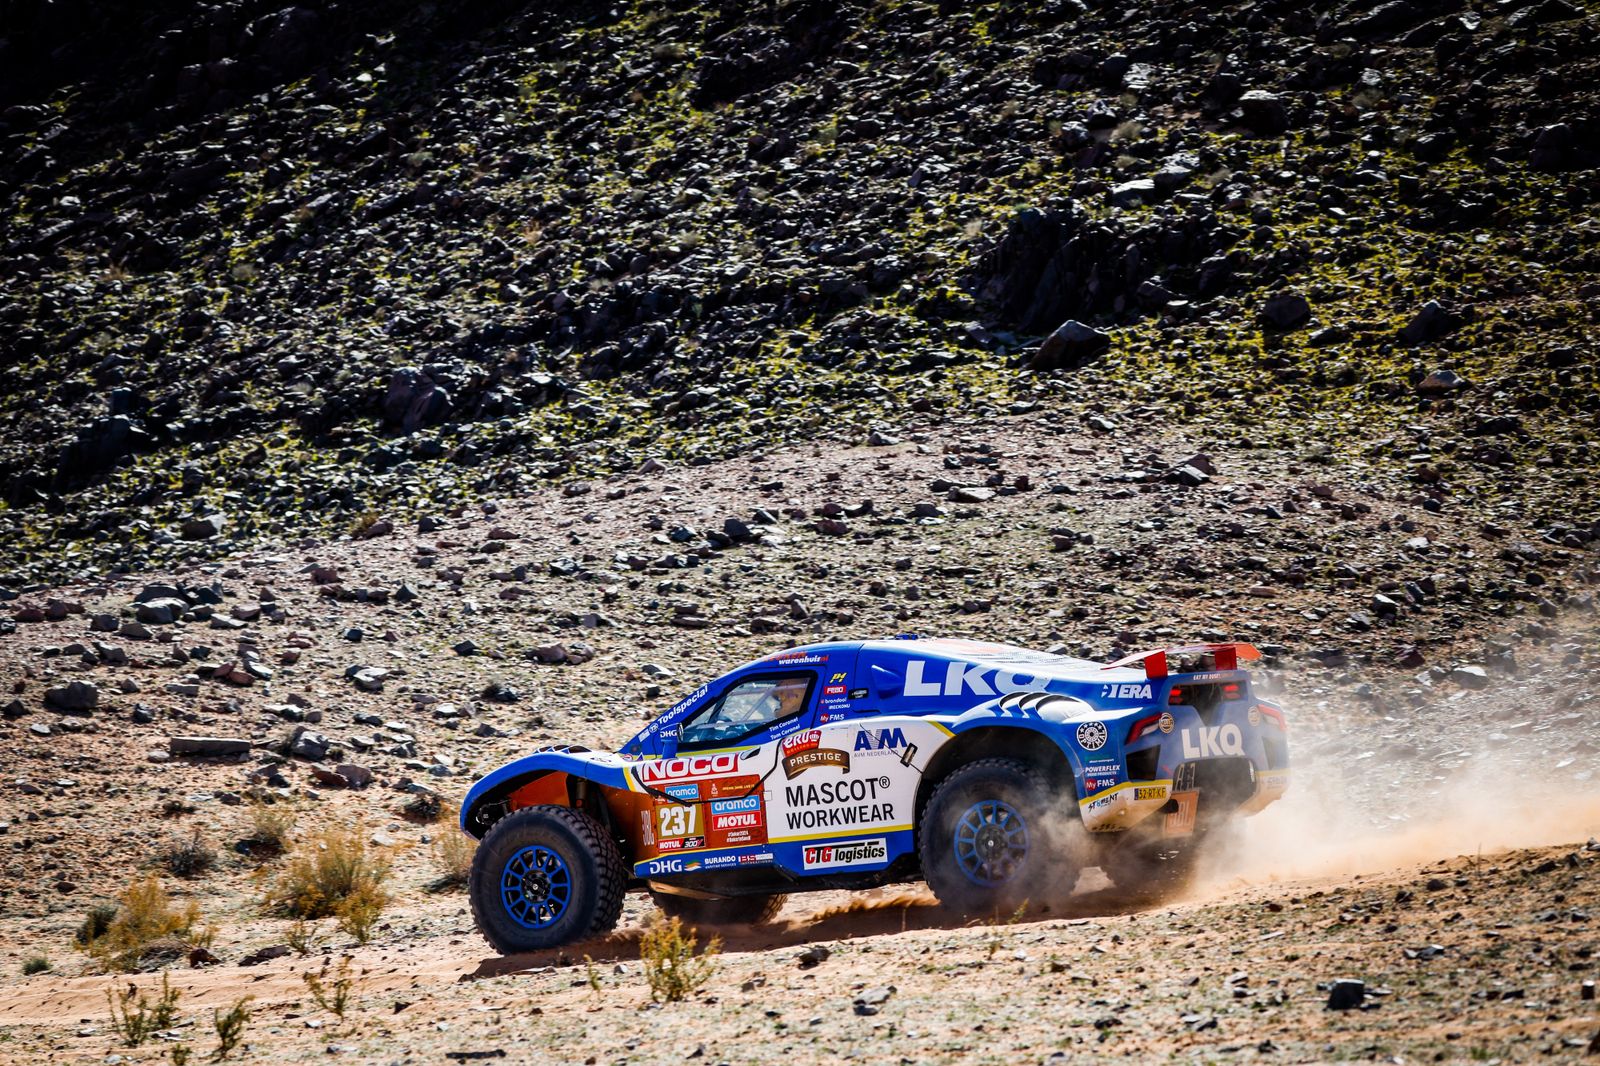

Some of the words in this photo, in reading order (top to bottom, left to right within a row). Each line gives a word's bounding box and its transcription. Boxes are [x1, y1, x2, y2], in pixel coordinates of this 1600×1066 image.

[658, 684, 708, 725] Toolspecial
[779, 717, 799, 728] Coronel
[829, 713, 845, 721] FMS
[660, 729, 678, 738] DHG
[770, 732, 781, 740] Tom
[781, 724, 801, 736] Coronel
[1181, 723, 1246, 759] LKQ
[643, 753, 736, 781] NOCO
[789, 752, 842, 767] PRESTIGE
[1085, 764, 1121, 773] POWERFLEX
[1097, 779, 1115, 788] FMS
[714, 798, 757, 811] aramco
[659, 804, 697, 837] 237
[717, 813, 757, 828] MOTUL
[786, 803, 895, 830] WORKWEAR
[659, 840, 681, 849] MOTUL
[704, 855, 736, 865] BURANDO
[804, 846, 833, 865] CTG
[834, 846, 885, 863] logistics
[650, 859, 683, 874] DHG
